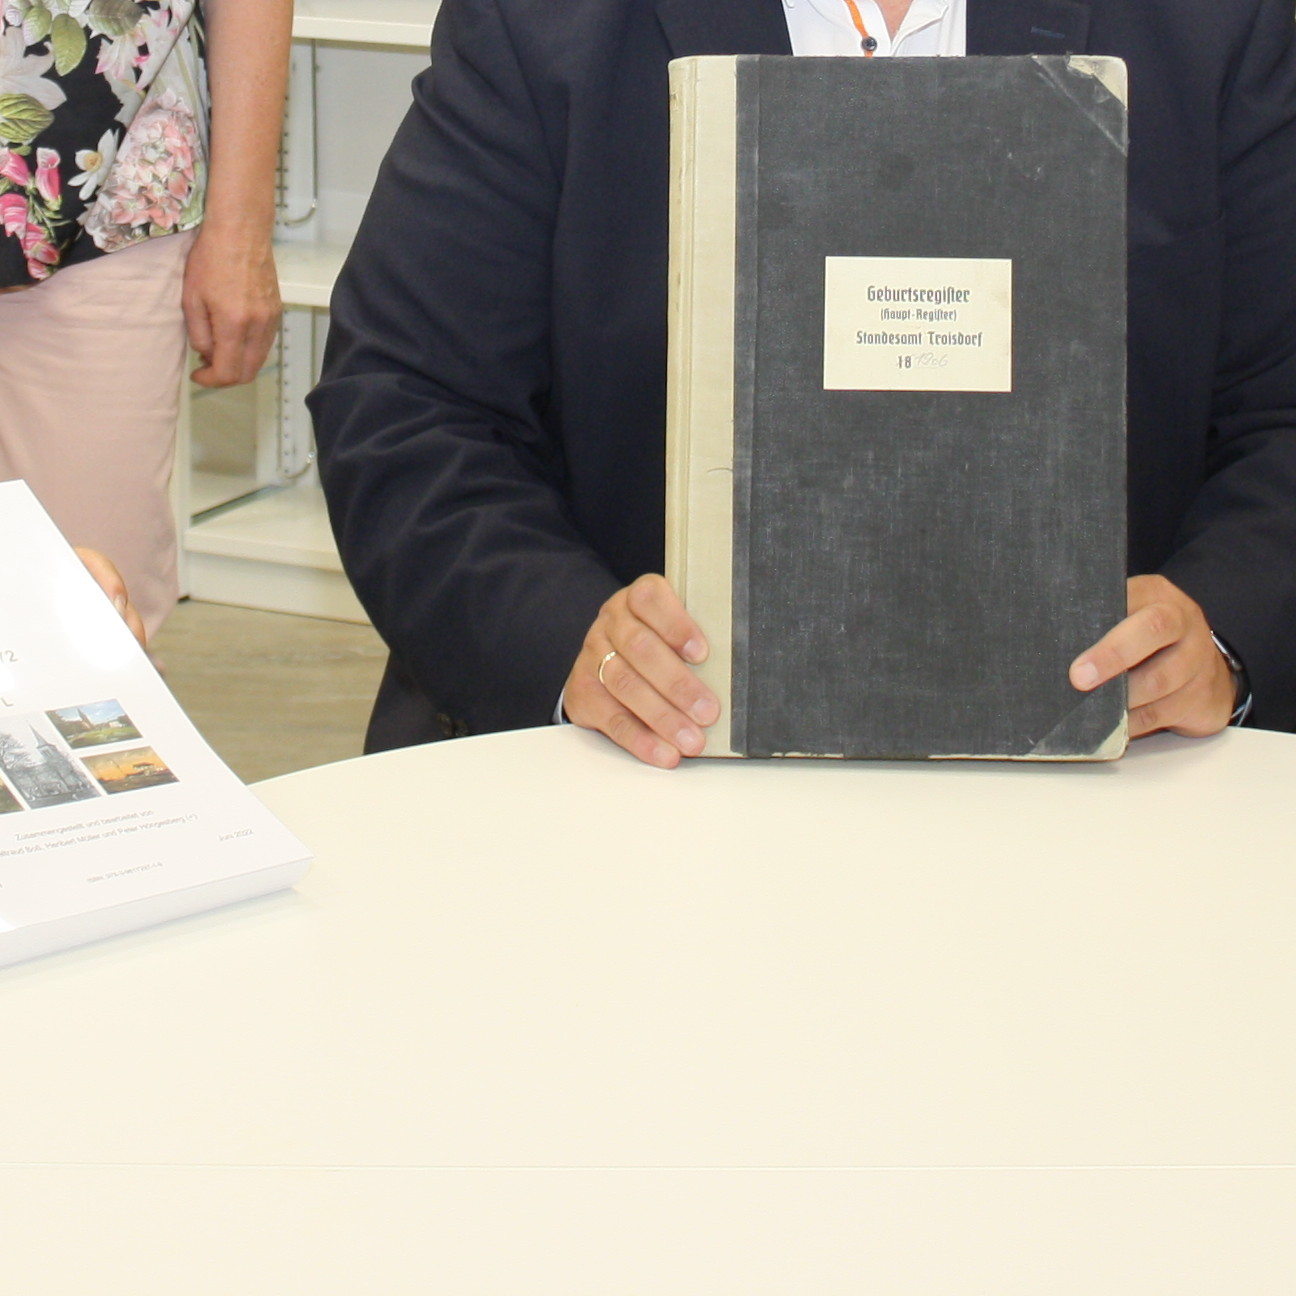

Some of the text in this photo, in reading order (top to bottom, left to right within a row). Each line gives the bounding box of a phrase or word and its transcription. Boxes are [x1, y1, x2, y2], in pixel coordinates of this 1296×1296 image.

[856, 330, 983, 347] Standesamt Troisdorf
[1, 697, 14, 708] L
